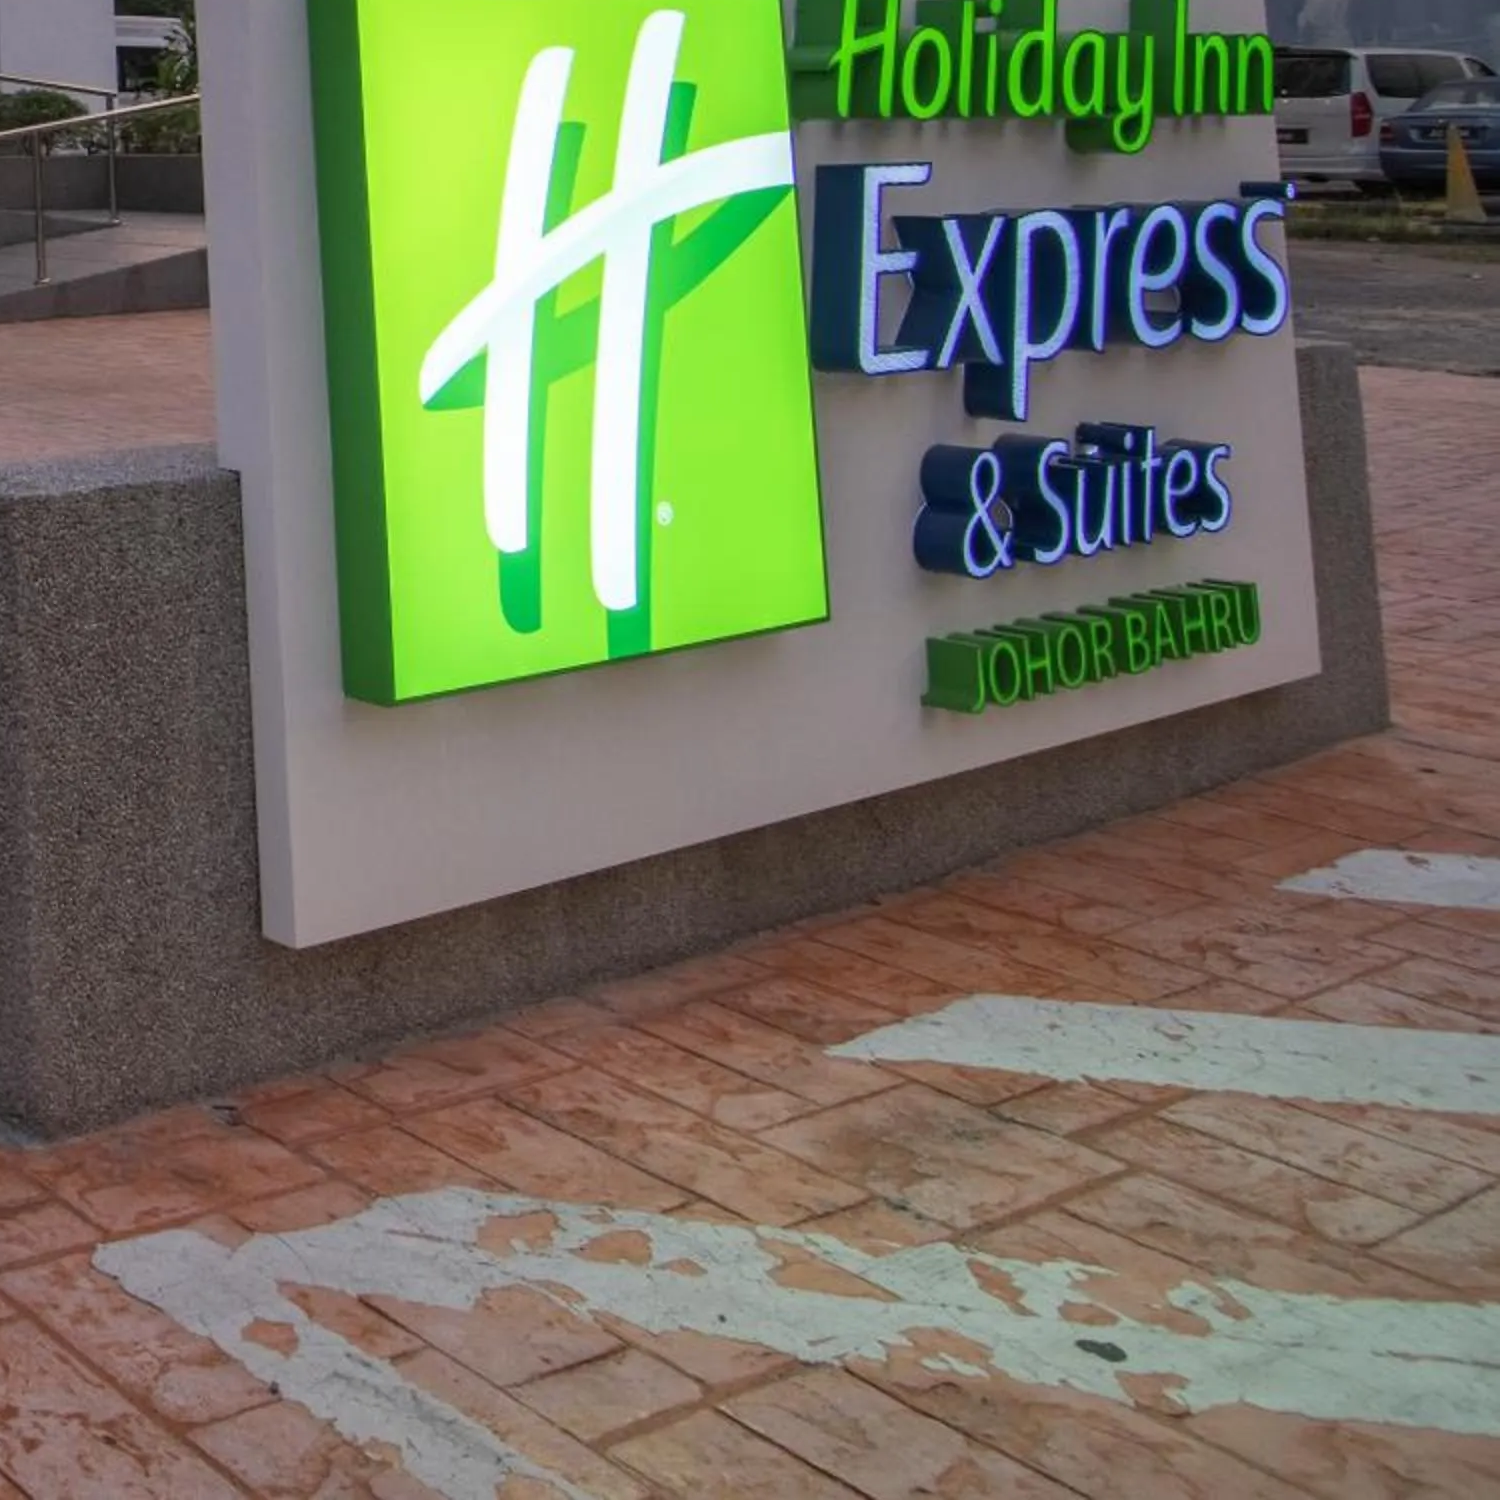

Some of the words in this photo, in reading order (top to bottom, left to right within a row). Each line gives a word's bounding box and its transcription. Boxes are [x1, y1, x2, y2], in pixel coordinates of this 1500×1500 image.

[858, 163, 1288, 420] Express
[962, 450, 1014, 579] &
[1032, 426, 1234, 564] Suites
[971, 616, 1118, 714] JOHOR
[1125, 581, 1261, 675] BAHRU
